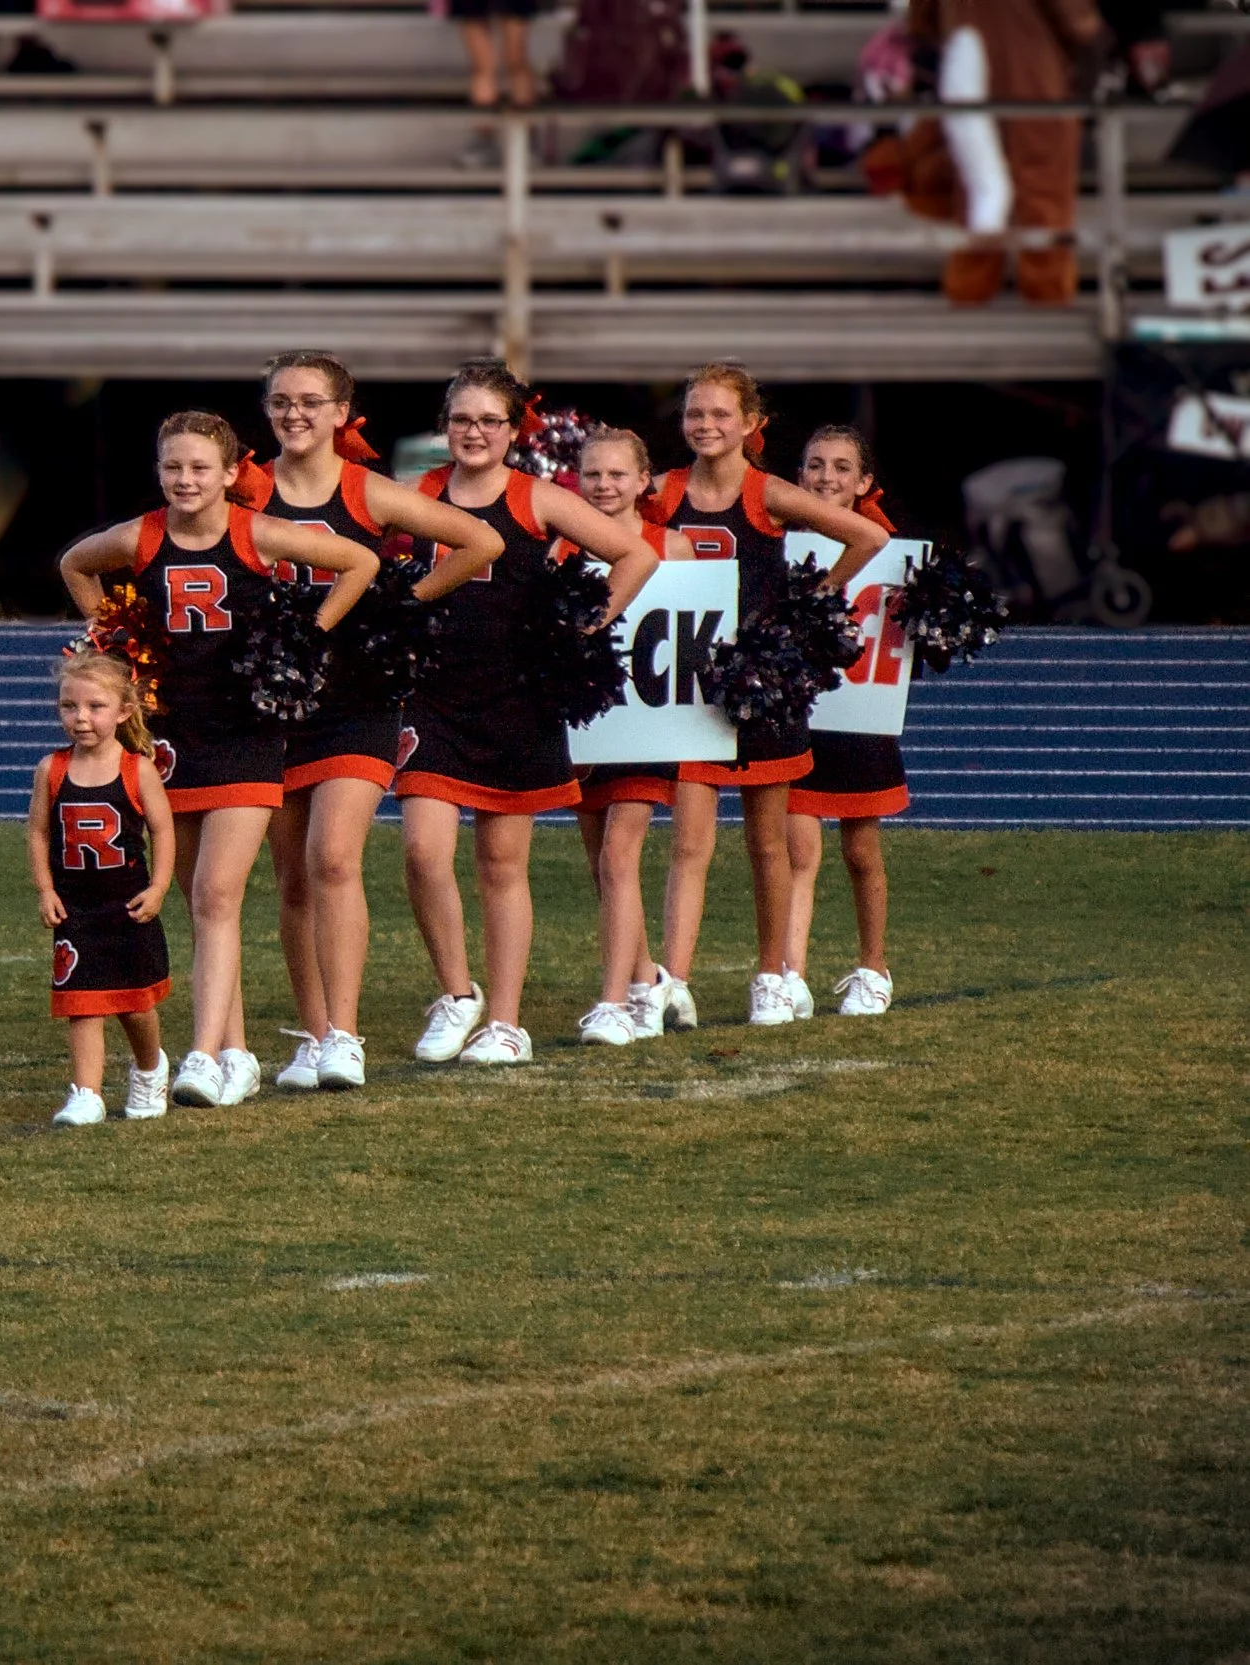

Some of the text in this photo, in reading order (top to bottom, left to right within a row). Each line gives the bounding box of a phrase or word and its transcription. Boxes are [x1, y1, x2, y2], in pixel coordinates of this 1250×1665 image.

[165, 565, 232, 632] R
[610, 607, 725, 708] CK
[60, 802, 126, 870] R
